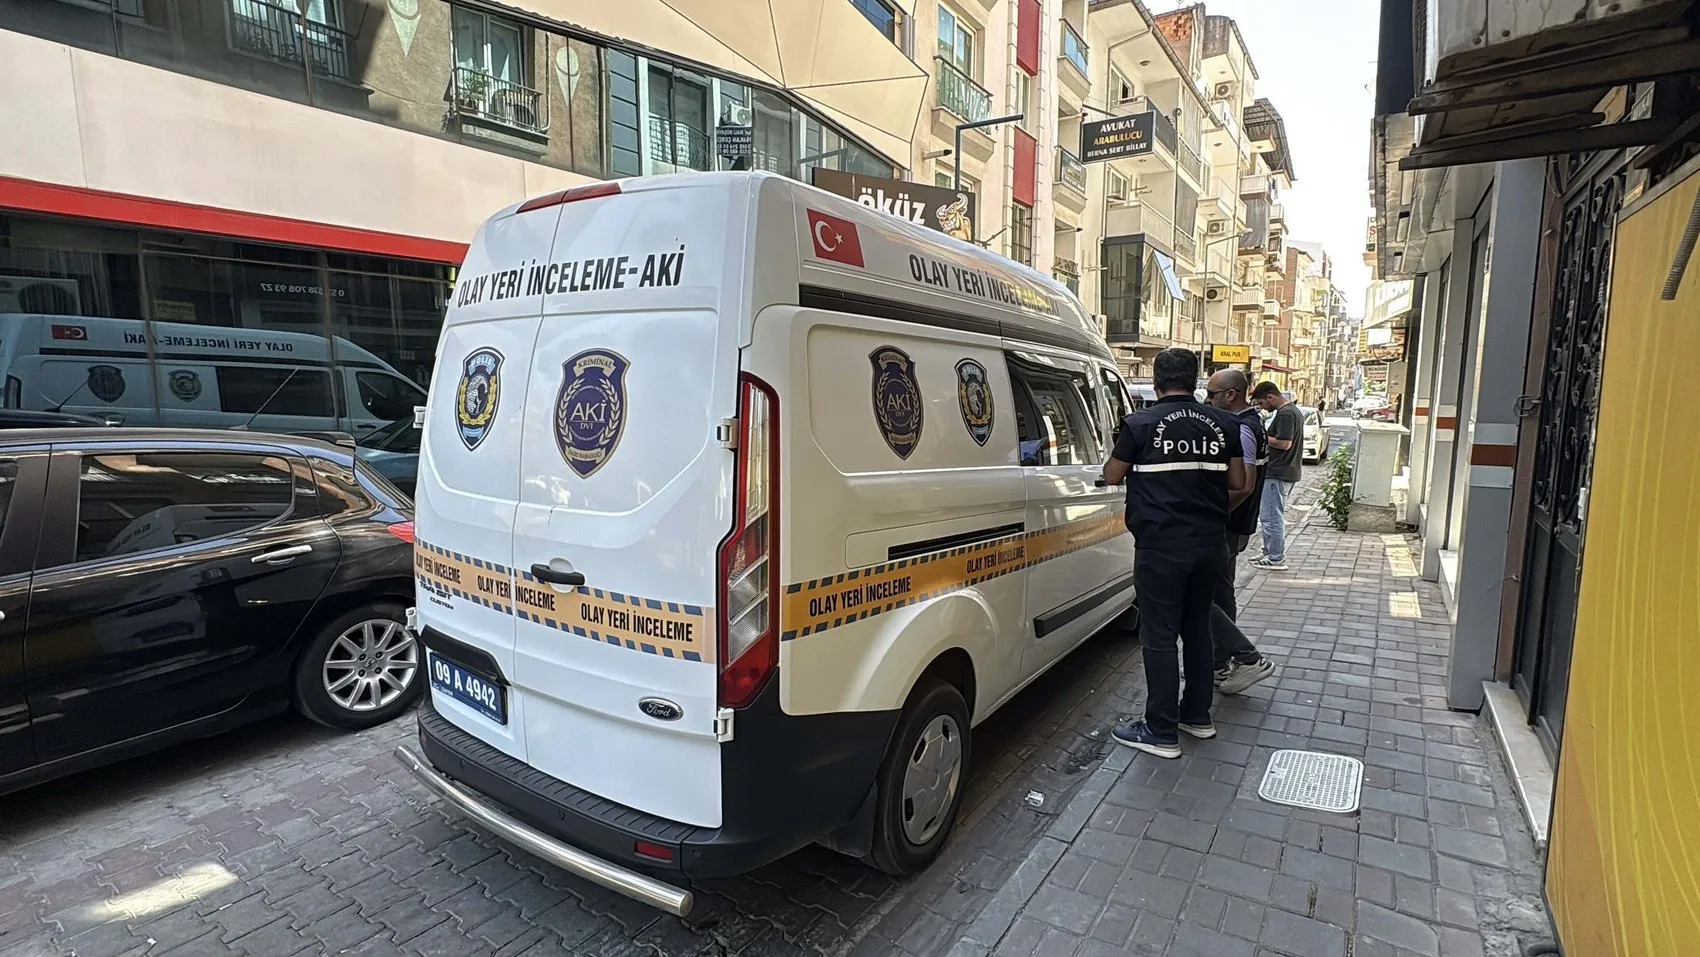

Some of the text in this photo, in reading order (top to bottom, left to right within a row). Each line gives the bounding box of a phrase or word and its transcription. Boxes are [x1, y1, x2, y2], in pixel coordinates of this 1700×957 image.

[1100, 119, 1136, 133] AVUKAT
[1093, 130, 1142, 146] ARABULUCU
[1087, 142, 1148, 158] BERNA SERT BİLLAY
[858, 187, 926, 225] öküz
[457, 244, 685, 308] OLAY YERİ İNCELEME-AKİ
[908, 254, 950, 288] OLAY
[952, 268, 986, 297] YERİ
[578, 356, 614, 370] KRİMİNAL
[570, 399, 608, 422] AKİ
[887, 391, 912, 410] AKİ
[580, 422, 594, 430] DVI
[1153, 420, 1166, 448] OLAY
[1164, 409, 1187, 422] YERİ
[1163, 436, 1220, 455] POLİS
[966, 558, 982, 574] OLAY
[477, 574, 556, 612] OLAY YERİ İNCELEME
[810, 576, 912, 618] OLAY YERİ İNCELEME
[581, 602, 693, 642] OLAY YERİ İNCELEME
[435, 660, 497, 711] 09 A 4942
[646, 702, 671, 718] Ford
